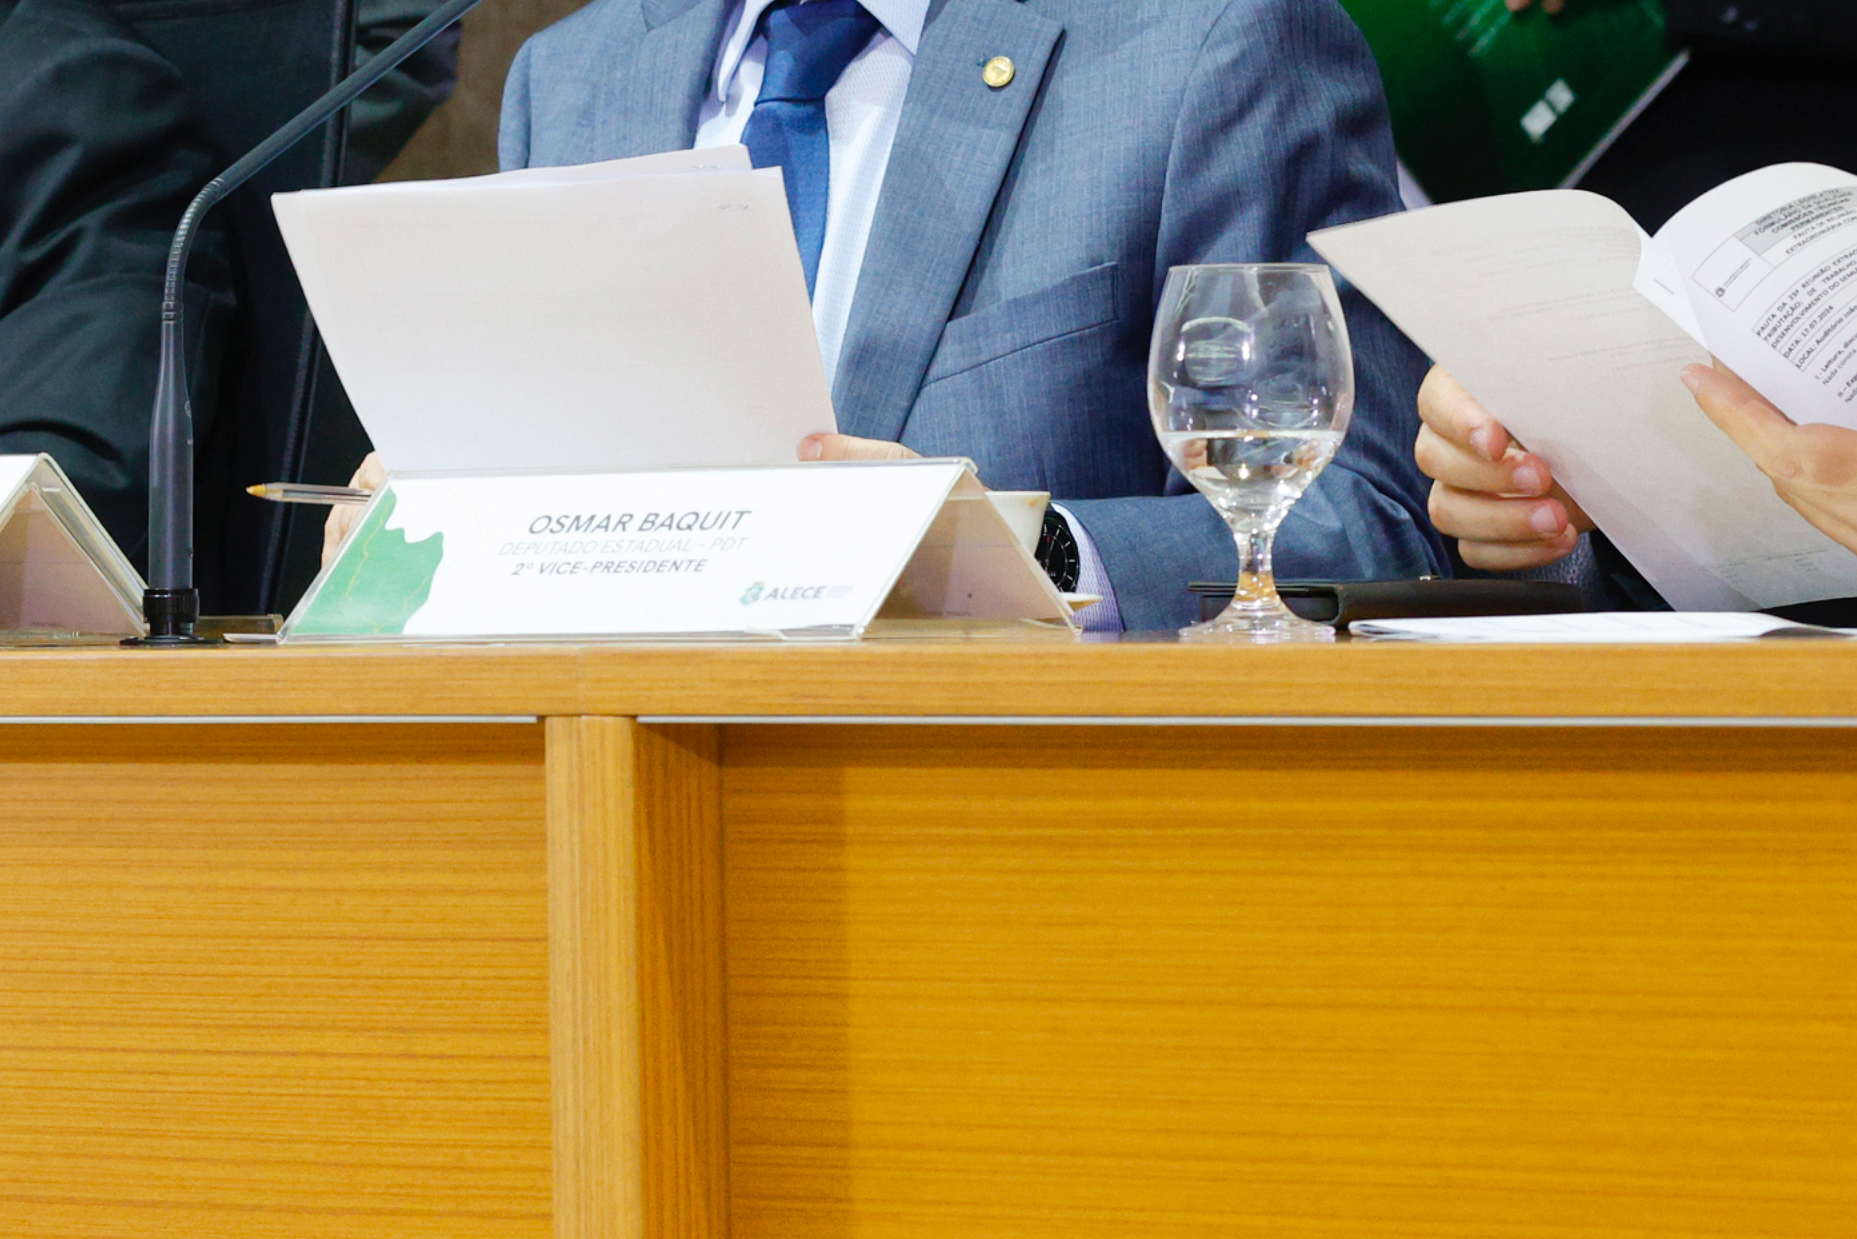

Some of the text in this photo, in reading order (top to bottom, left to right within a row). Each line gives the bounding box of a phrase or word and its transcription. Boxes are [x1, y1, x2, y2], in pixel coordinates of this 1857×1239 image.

[1793, 226, 1816, 240] PAUTA
[1756, 313, 1777, 337] PAUTA
[1776, 302, 1788, 313] DA
[1801, 265, 1831, 289] REUNIÃO
[1807, 287, 1817, 297] DE
[1771, 289, 1829, 349] DESENVOLVIMENTO
[1828, 281, 1840, 291] DO
[1783, 337, 1802, 359] DATA:
[1795, 344, 1817, 368] LOCAL:
[1816, 318, 1844, 345] Auditório
[1821, 350, 1845, 372] Leitura,
[1822, 368, 1839, 385] Nada
[528, 510, 752, 535] OSMAR BAQUIT
[498, 542, 599, 556] DEPUTADO
[600, 539, 691, 554] ESTADUAL
[707, 536, 750, 552] PDT
[538, 559, 709, 575] VICE-PRESIDENTE
[764, 586, 827, 600] ALECE
